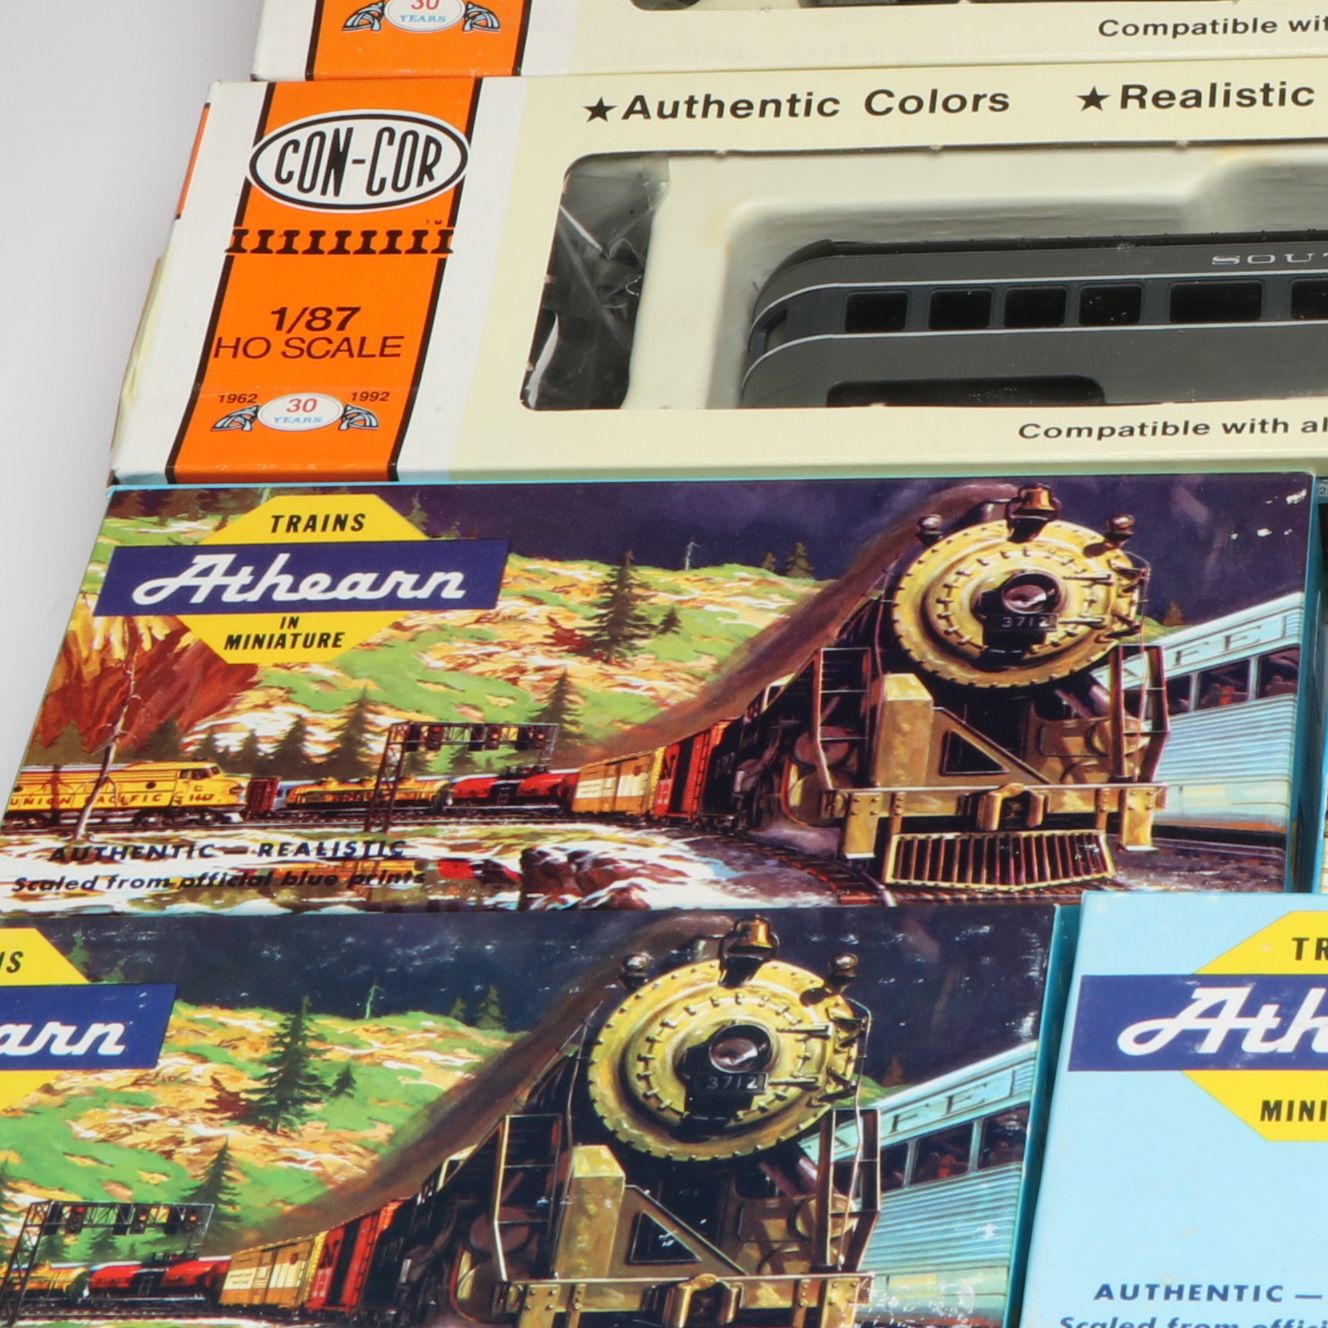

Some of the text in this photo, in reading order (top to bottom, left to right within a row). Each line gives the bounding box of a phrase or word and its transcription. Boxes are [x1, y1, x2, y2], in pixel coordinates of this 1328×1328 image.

[400, 13, 446, 23] YEARS
[1098, 17, 1277, 39] Compatible
[621, 92, 841, 121] Authentic
[864, 88, 1011, 116] Colors
[1119, 80, 1315, 110] Realistic
[275, 126, 441, 197] CON-COR
[270, 306, 361, 332] 1/87
[213, 335, 405, 359] HO SCALE
[217, 393, 258, 404] 1962
[350, 391, 390, 402] 1992
[286, 398, 318, 414] 30
[273, 414, 323, 424] YEARS
[1018, 421, 1210, 440] Compatible
[1221, 416, 1290, 435] with
[270, 513, 366, 533] TRAINS
[132, 554, 466, 604] Athearn
[280, 617, 299, 629] IN
[1002, 617, 1050, 627] 3712
[225, 632, 346, 650] MINIATURE
[10, 796, 71, 806] UNION
[49, 840, 407, 862] AUTHENTIC REALISTIC
[12, 871, 426, 892] Scaled from official blue prints
[707, 1076, 758, 1089] 3712
[1094, 1284, 1284, 1302] AUTHENTIC
